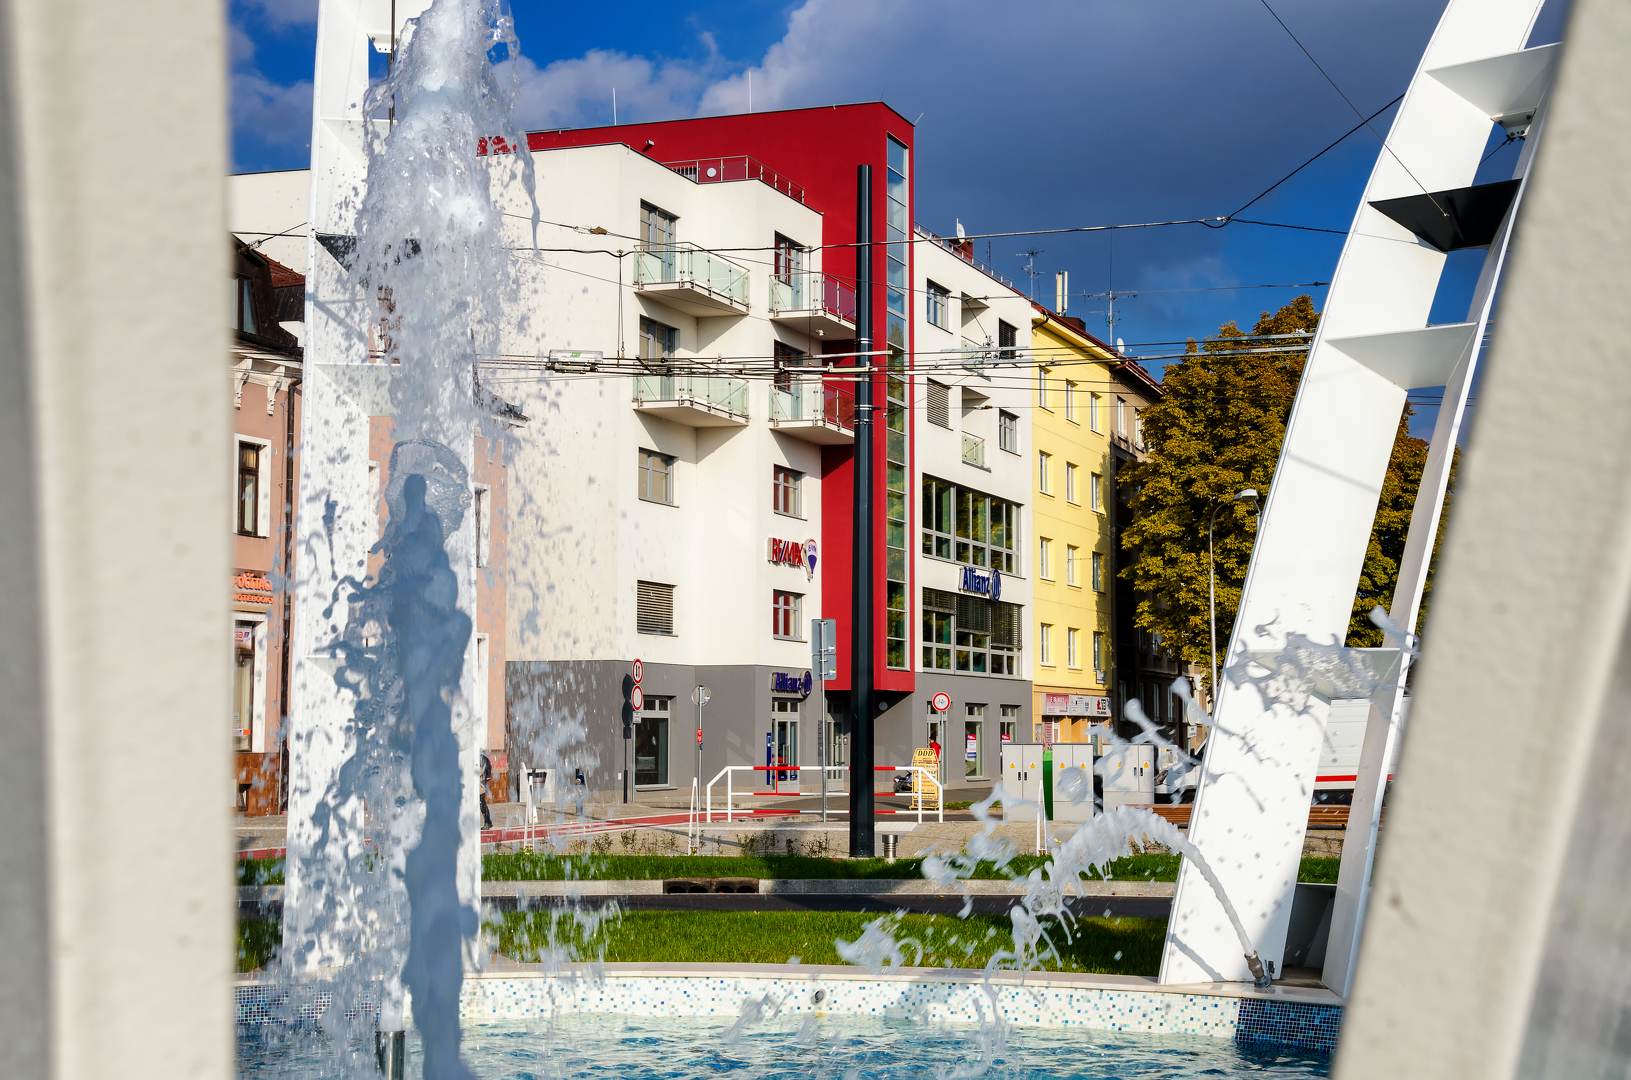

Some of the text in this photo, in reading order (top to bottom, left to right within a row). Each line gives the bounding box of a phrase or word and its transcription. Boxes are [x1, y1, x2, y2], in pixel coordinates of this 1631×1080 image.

[772, 537, 804, 566] RE/MAX
[963, 566, 991, 594] Allianz
[775, 672, 802, 691] Allianz
